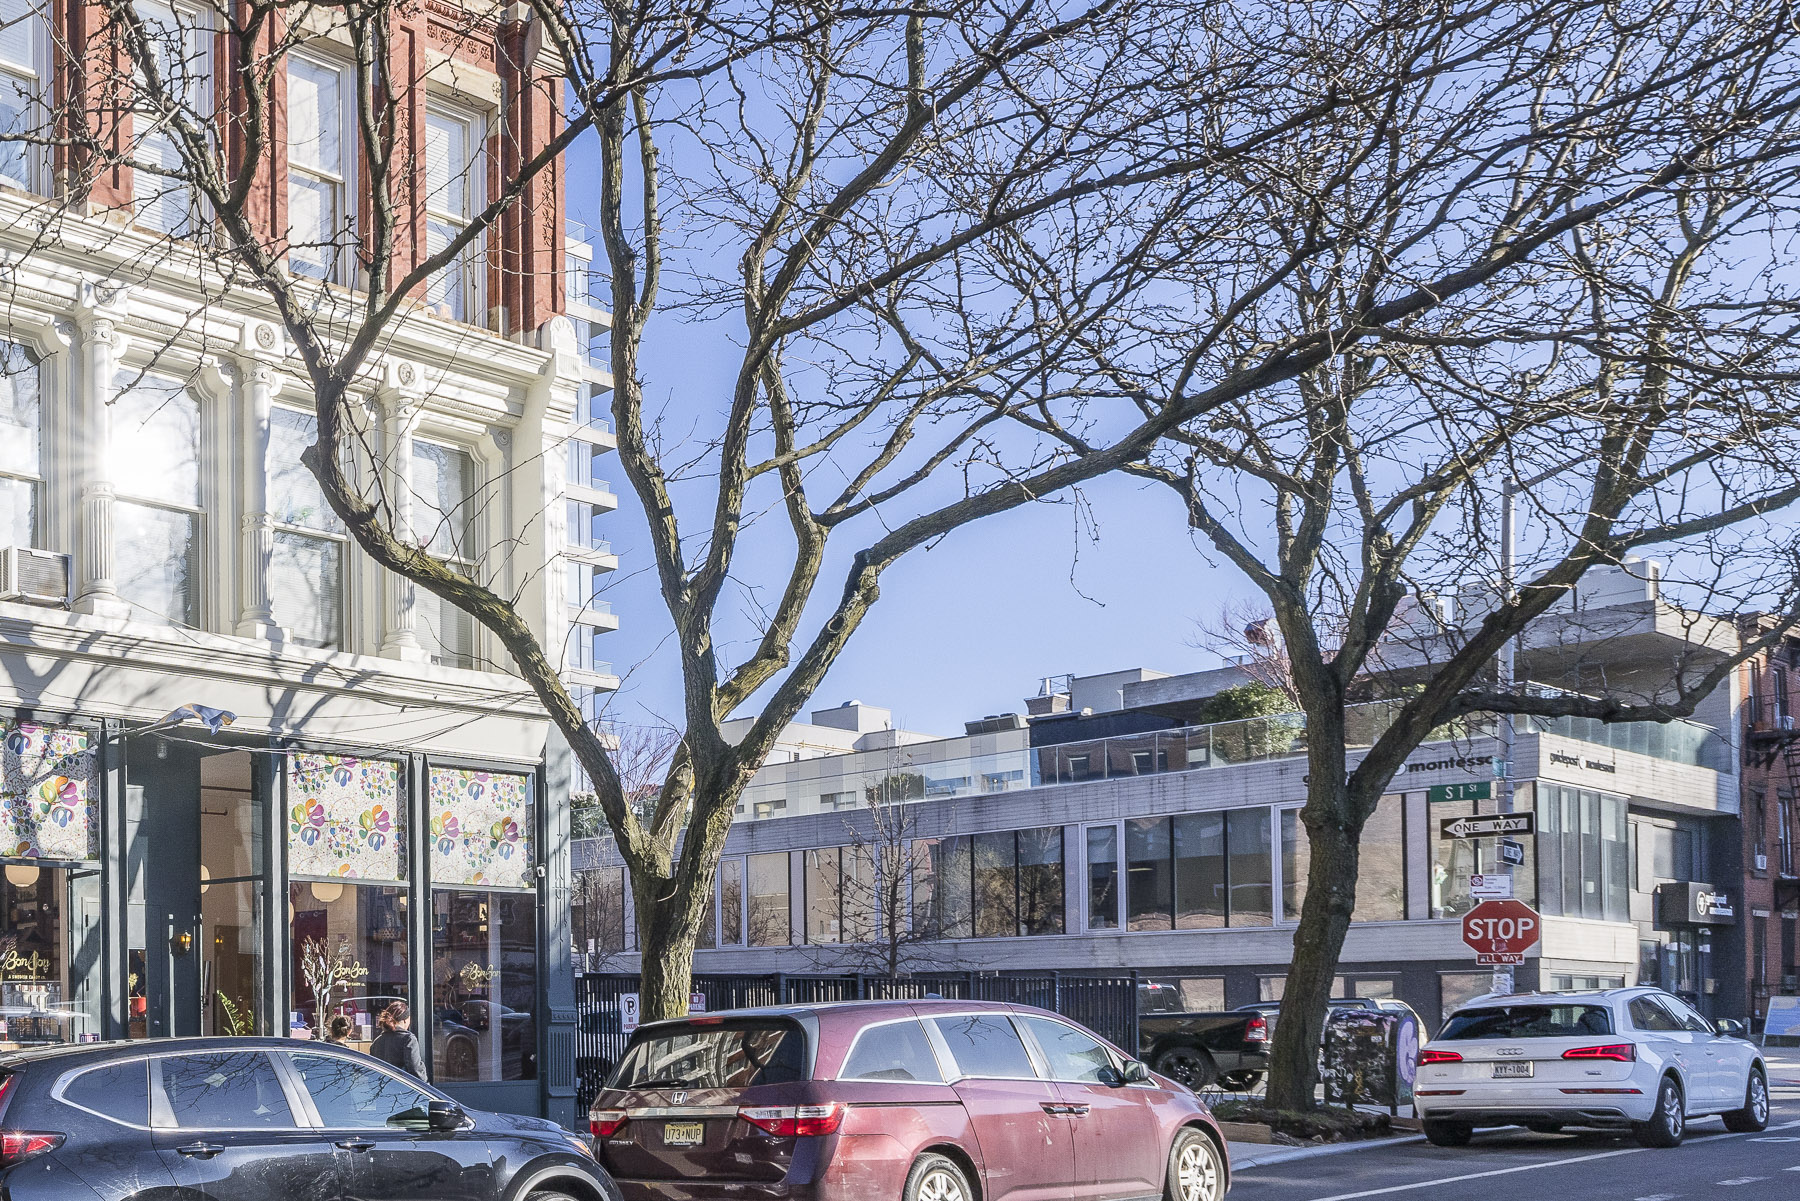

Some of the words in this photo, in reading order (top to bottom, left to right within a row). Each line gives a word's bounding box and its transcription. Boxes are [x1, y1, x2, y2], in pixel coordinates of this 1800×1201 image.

[1408, 756, 1494, 773] montesso
[1445, 786, 1454, 799] S
[1459, 785, 1464, 799] 1
[1453, 822, 1480, 834] ONE
[1492, 819, 1522, 830] WAY
[1467, 917, 1535, 940] STOP
[1, 950, 51, 971] BonBon
[332, 960, 369, 979] BonBon
